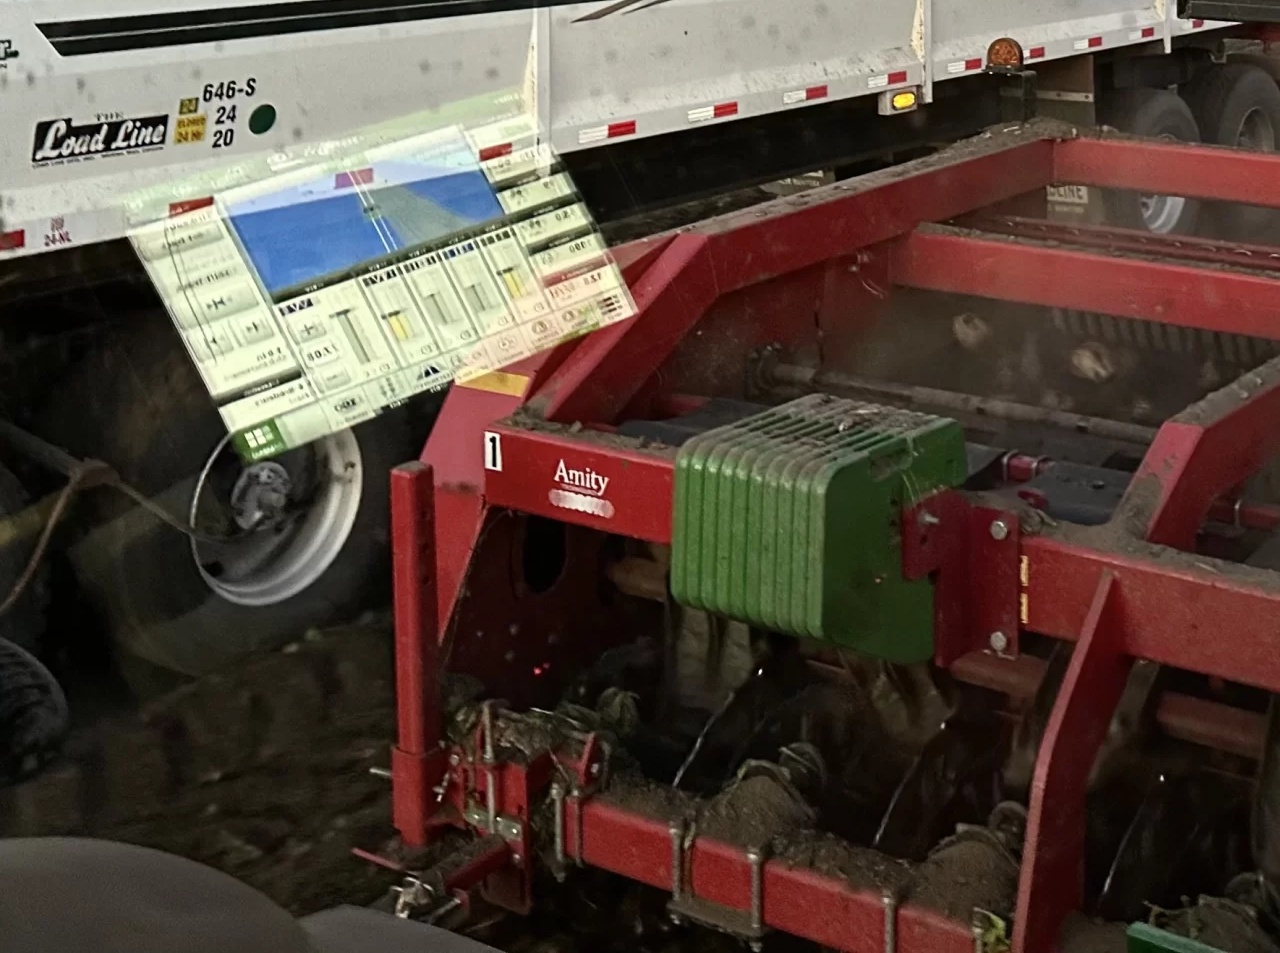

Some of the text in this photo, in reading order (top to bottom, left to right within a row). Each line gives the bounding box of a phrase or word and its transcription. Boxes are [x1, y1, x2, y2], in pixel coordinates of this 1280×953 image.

[203, 78, 256, 102] 646-S
[215, 105, 236, 125] 24
[35, 120, 107, 160] Load
[110, 120, 165, 149] Line
[212, 129, 233, 148] 20
[489, 436, 497, 468] 1
[553, 458, 610, 496] Amity
